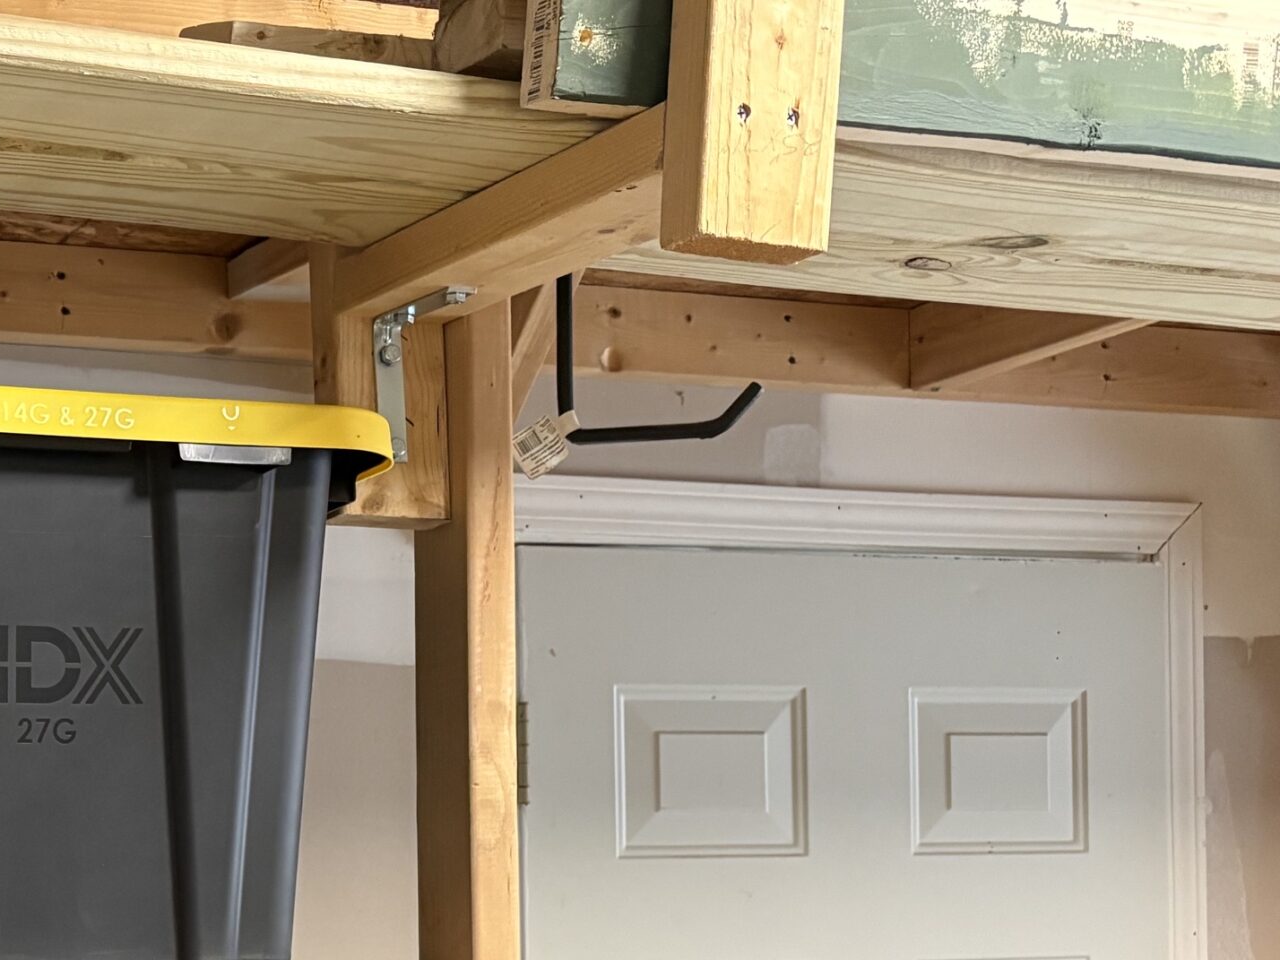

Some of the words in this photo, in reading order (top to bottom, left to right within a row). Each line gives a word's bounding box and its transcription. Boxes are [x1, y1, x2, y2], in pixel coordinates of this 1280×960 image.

[2, 401, 51, 425] 14G
[60, 406, 76, 426] &
[84, 406, 136, 429] 27G
[17, 718, 77, 744] 27G
